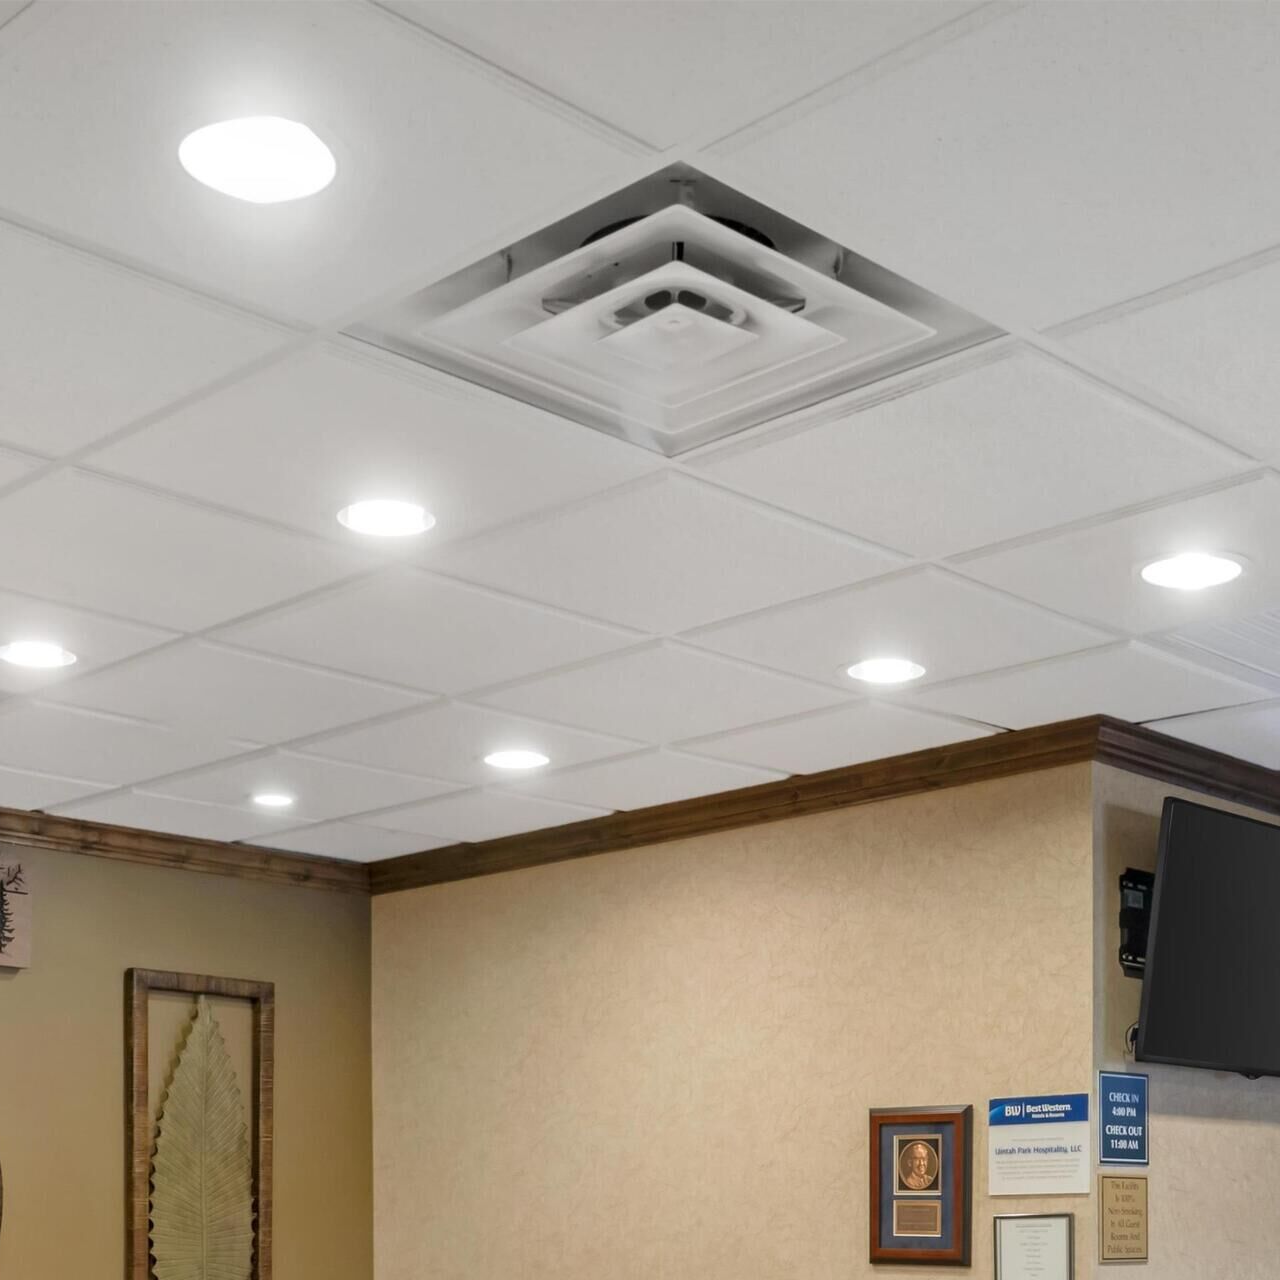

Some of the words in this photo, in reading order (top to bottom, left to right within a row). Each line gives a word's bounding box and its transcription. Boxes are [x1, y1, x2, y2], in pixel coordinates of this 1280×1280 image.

[1109, 1092, 1130, 1102] CHECK
[1131, 1094, 1140, 1103] IN
[1005, 1105, 1021, 1116] BW
[1112, 1107, 1125, 1116] 4:00
[1126, 1107, 1136, 1117] PM
[1105, 1125, 1127, 1135] CHECK
[1128, 1126, 1143, 1136] OUT
[1111, 1139, 1127, 1149] 11:00
[1128, 1140, 1139, 1149] AM
